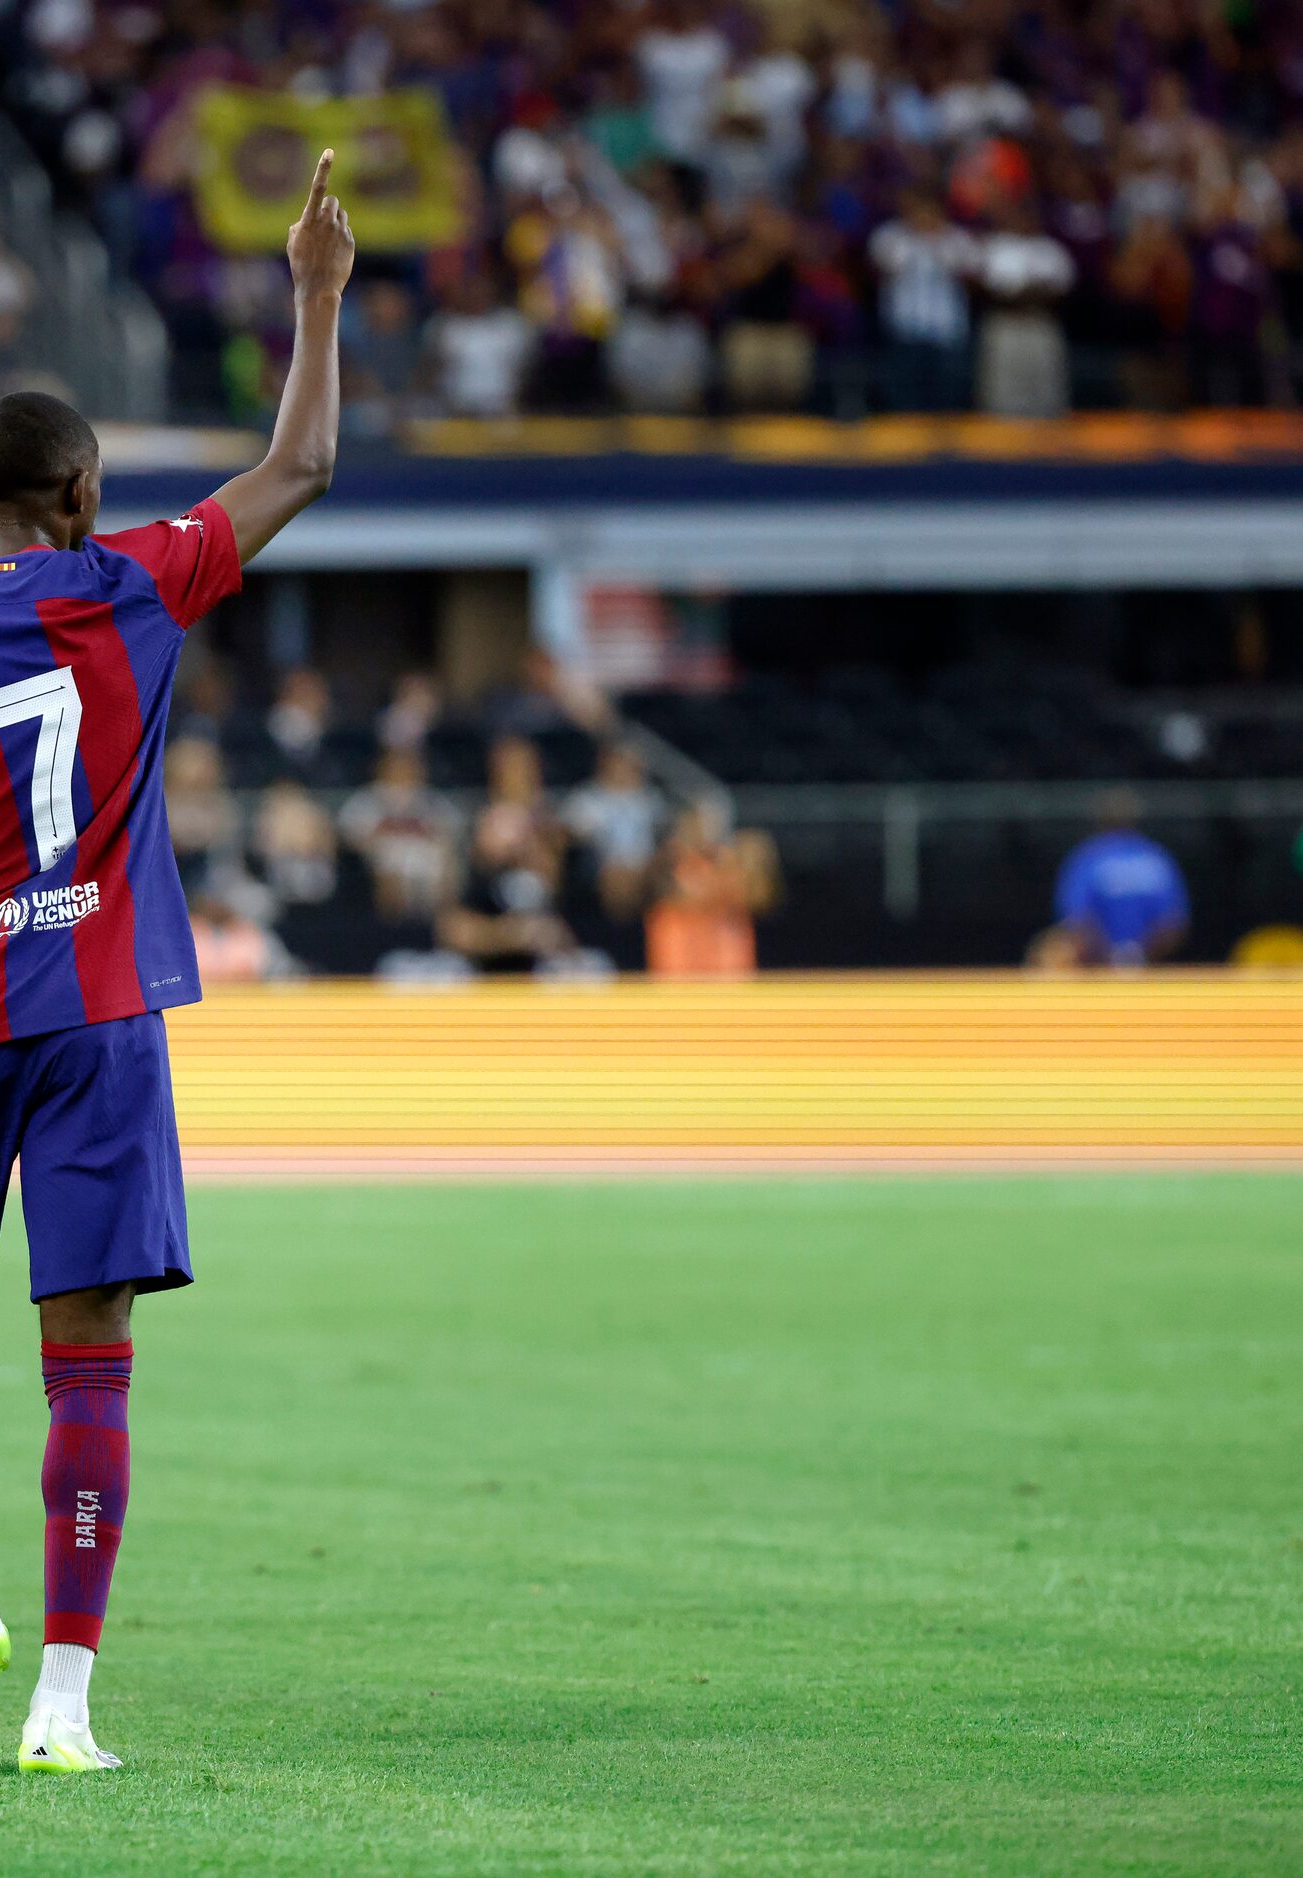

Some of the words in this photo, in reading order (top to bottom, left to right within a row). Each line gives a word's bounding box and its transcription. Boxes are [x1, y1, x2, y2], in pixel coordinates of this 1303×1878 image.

[32, 881, 100, 908] UNHCR
[32, 894, 100, 925] ACNUR
[75, 1490, 102, 1548] BARÇA
